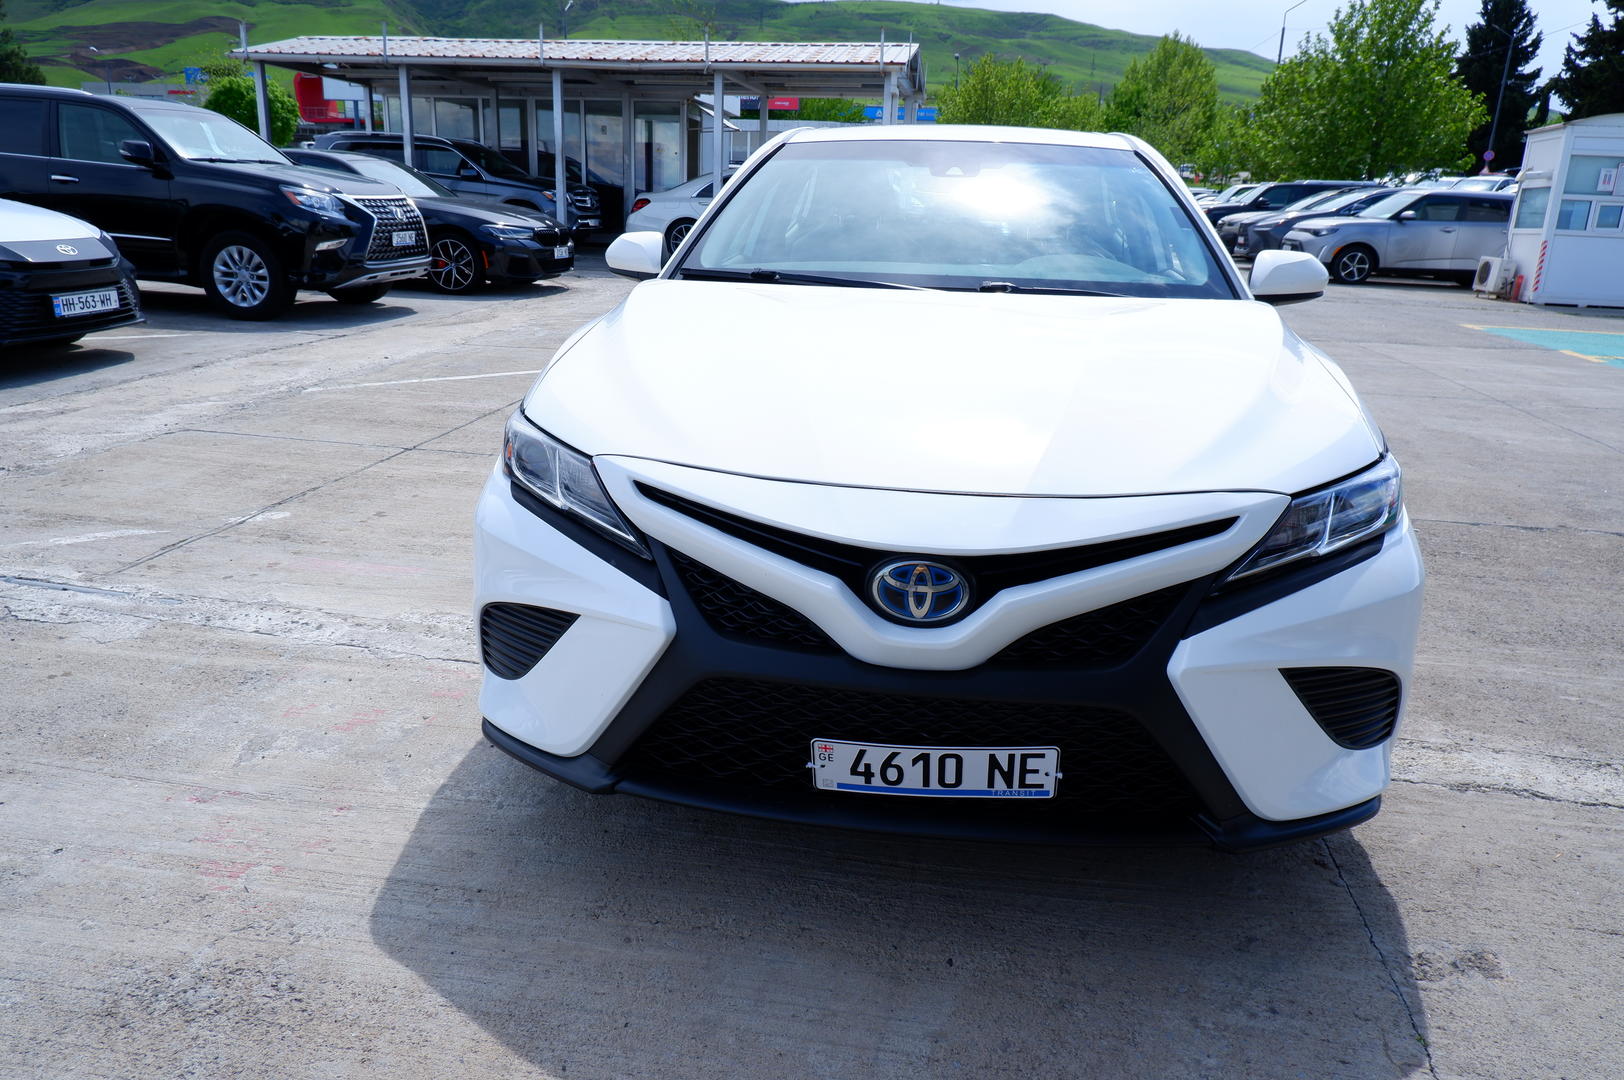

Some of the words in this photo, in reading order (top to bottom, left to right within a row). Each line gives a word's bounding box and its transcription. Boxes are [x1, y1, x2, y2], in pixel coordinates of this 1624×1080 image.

[61, 293, 112, 312] HH-563-WH
[819, 752, 834, 762] GE
[850, 749, 963, 788] 4610
[987, 753, 1046, 789] NE
